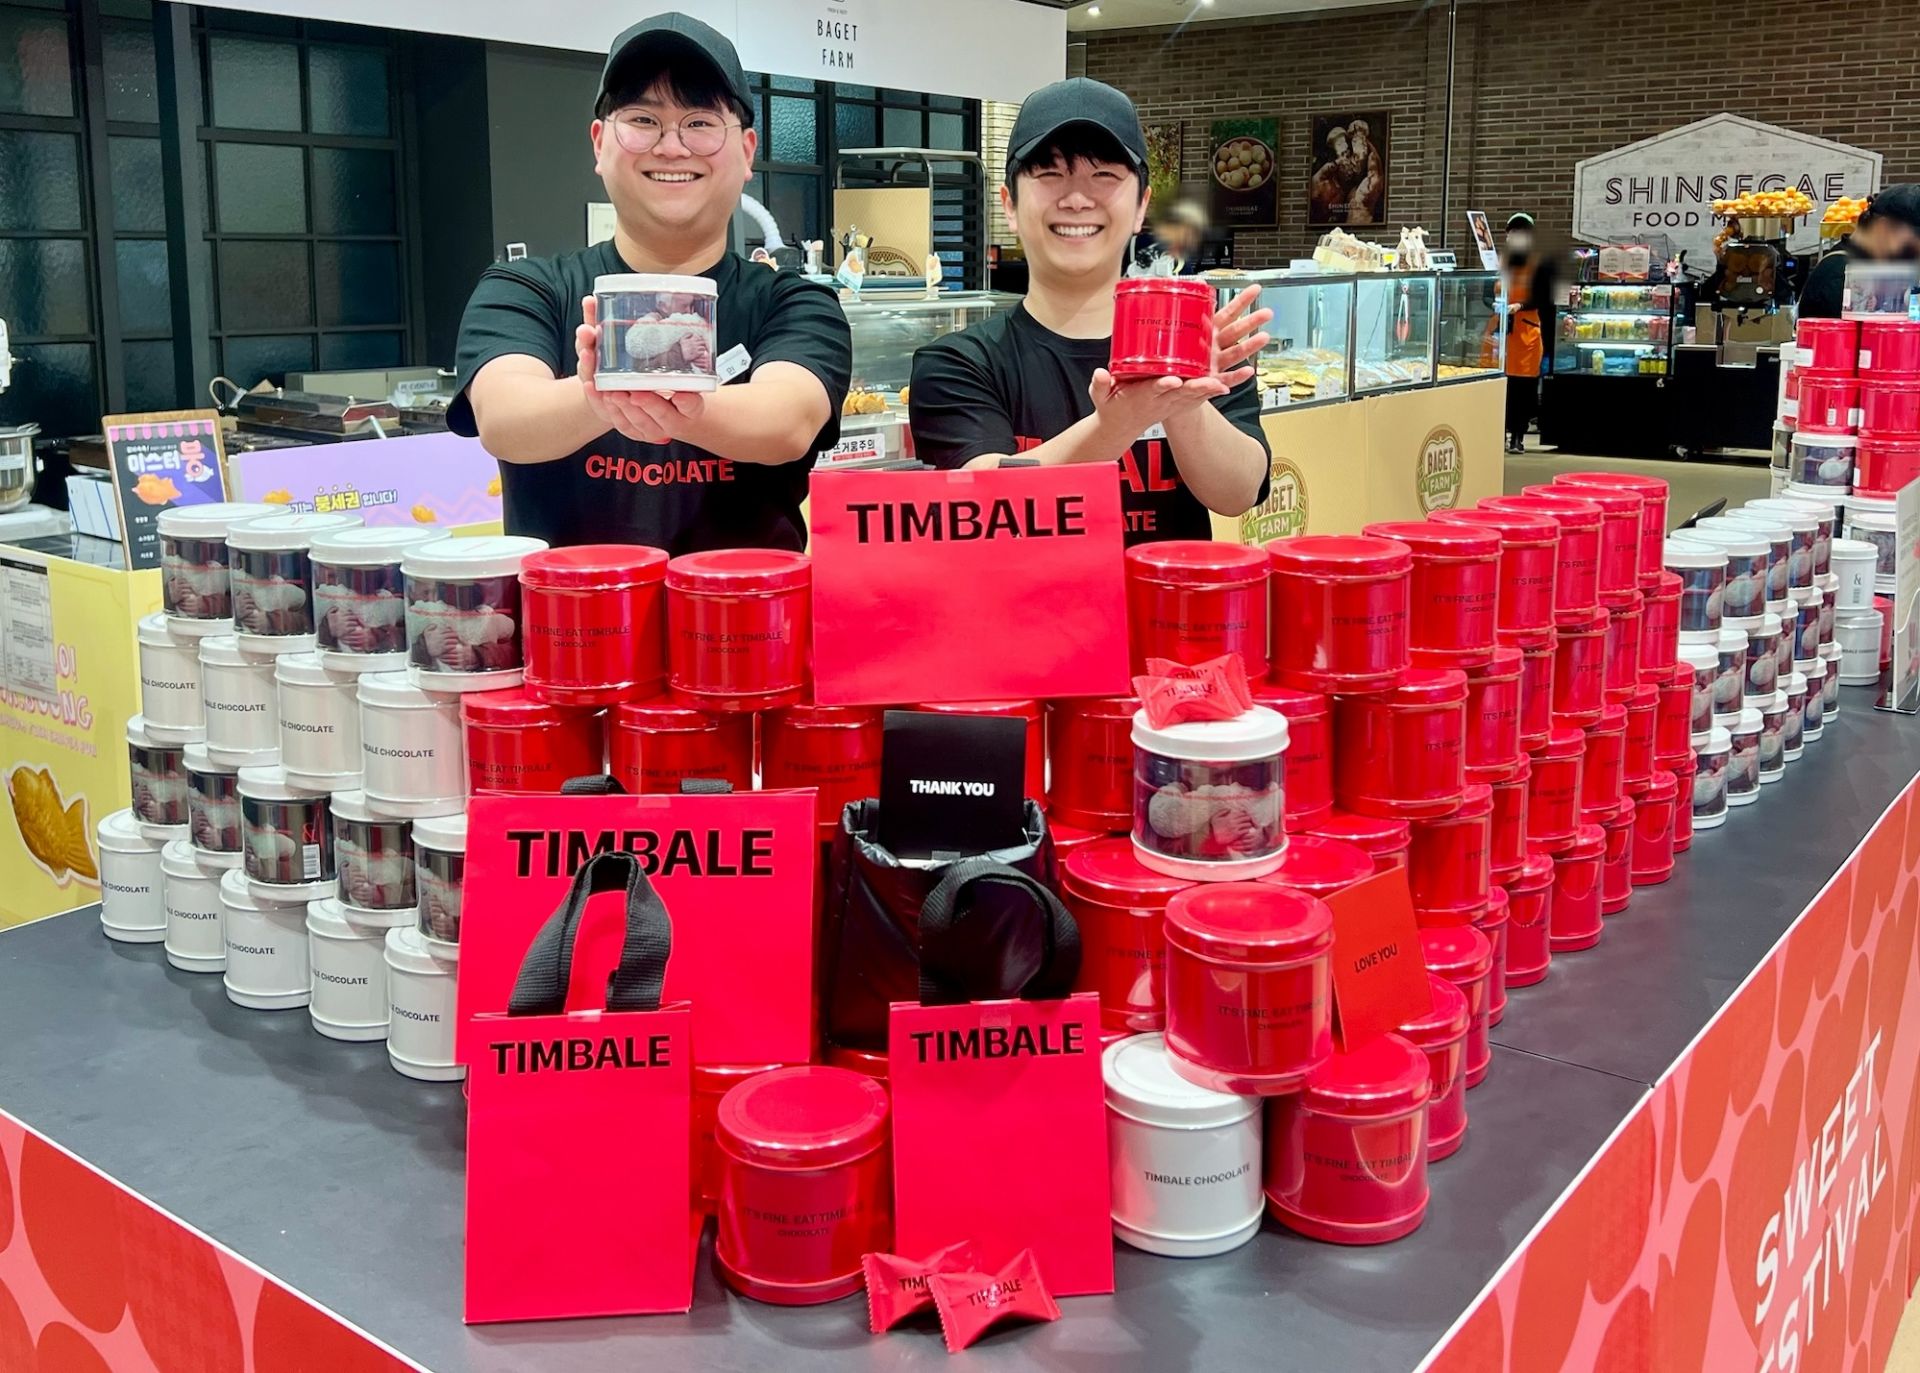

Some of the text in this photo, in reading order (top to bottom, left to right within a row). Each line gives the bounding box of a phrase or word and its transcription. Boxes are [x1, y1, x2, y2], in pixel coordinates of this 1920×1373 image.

[817, 19, 859, 42] BAGET
[822, 48, 854, 69] FARM
[1606, 173, 1845, 205] SHINSEGAE
[1633, 211, 1700, 228] FOOD
[1427, 447, 1454, 475] BAGET
[585, 454, 736, 487] CHOCOLATE
[1430, 475, 1450, 492] FARM
[846, 495, 1086, 544] TIMBALE
[1260, 515, 1290, 539] FARM
[742, 630, 784, 642] TIMBALE
[151, 679, 196, 691] CHOCOLATE
[217, 702, 267, 712] CHOCOLATE
[287, 721, 335, 734] CHOCOLATE
[379, 747, 435, 758] CHOCOLATE
[909, 779, 995, 796] THANK YOU
[108, 883, 151, 895] CHOCOLATE
[174, 909, 218, 921] CHOCOLATE
[232, 942, 276, 956] CHOCOLATE
[1355, 943, 1398, 974] LOVE YOU
[320, 971, 369, 986] CHOCOLATE
[395, 1007, 441, 1023] CHOCOLATE
[910, 1023, 1085, 1063] TIMBALE
[489, 1035, 671, 1075] TIMBALE
[1144, 1162, 1250, 1186] TIMBALE CHOCOLATE
[1755, 1025, 1882, 1327] SWEET
